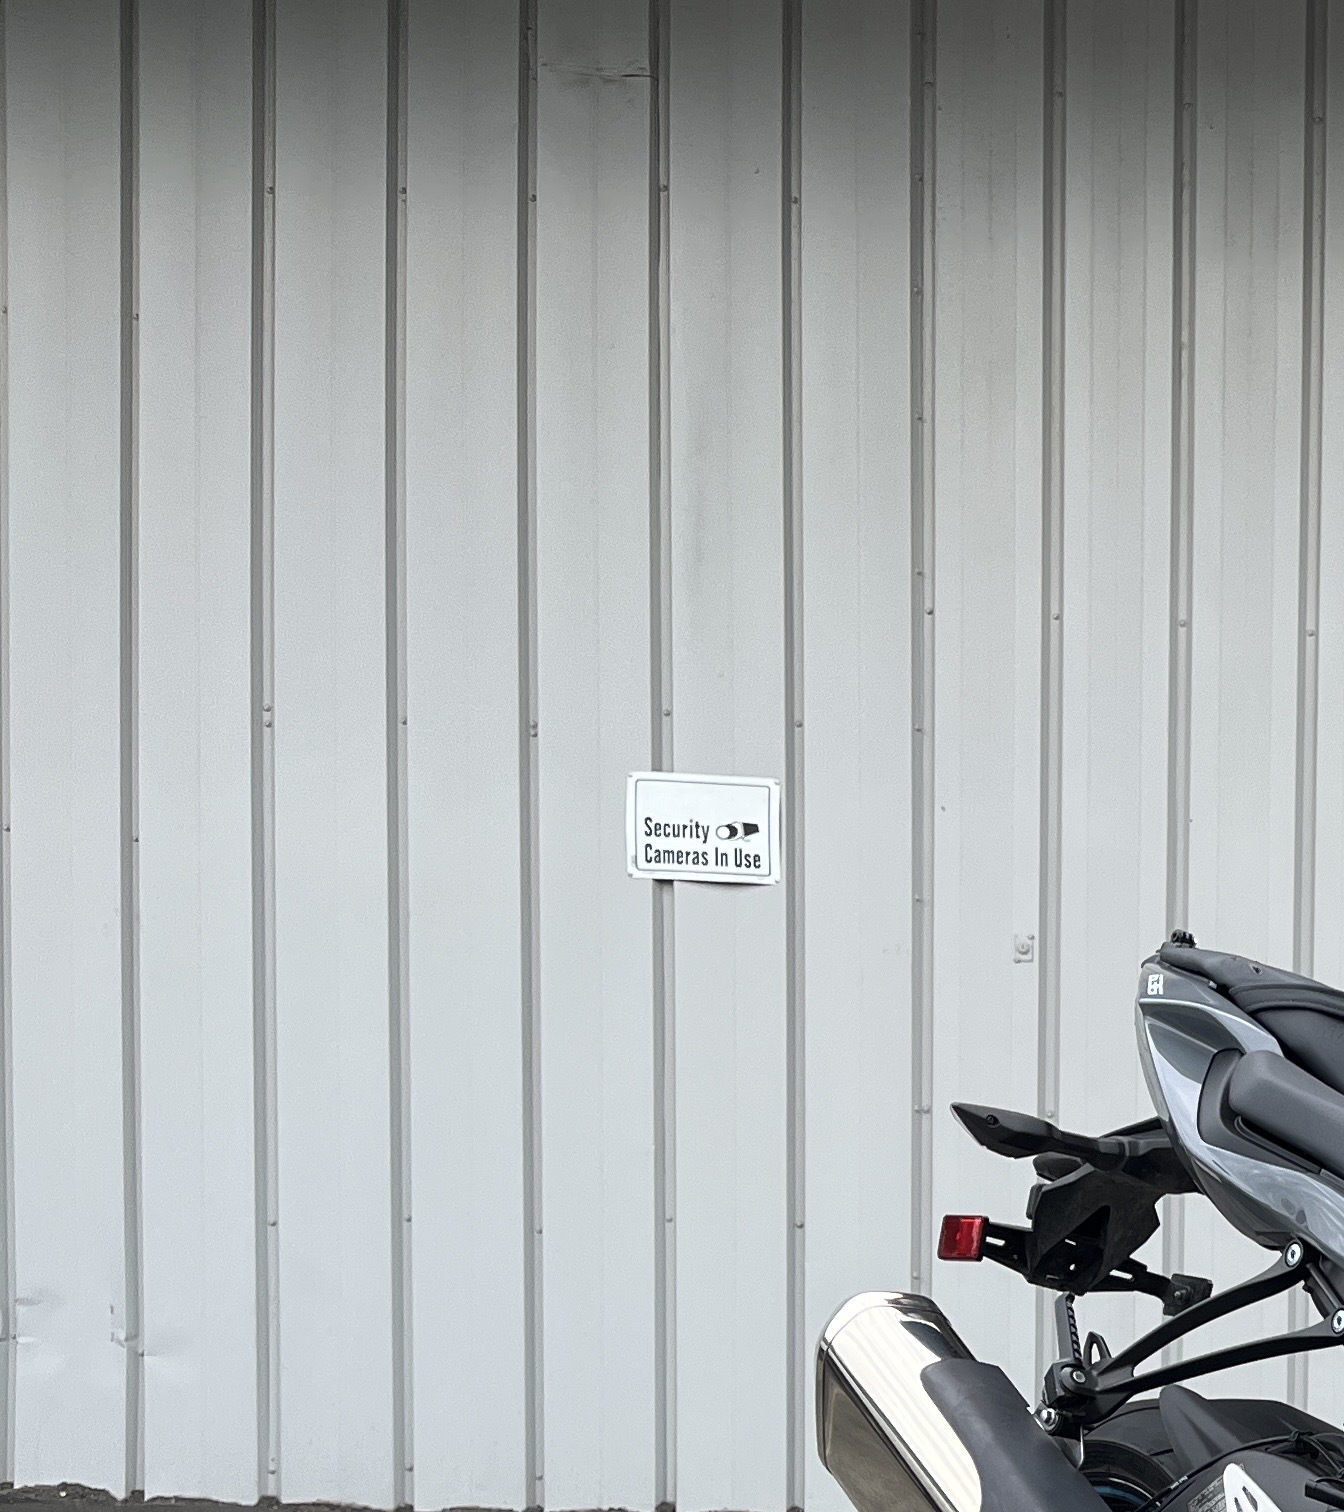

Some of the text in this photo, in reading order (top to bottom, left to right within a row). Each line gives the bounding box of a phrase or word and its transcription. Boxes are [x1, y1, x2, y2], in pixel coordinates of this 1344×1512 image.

[644, 817, 710, 844] Security
[644, 843, 761, 869] Cameras In Use
